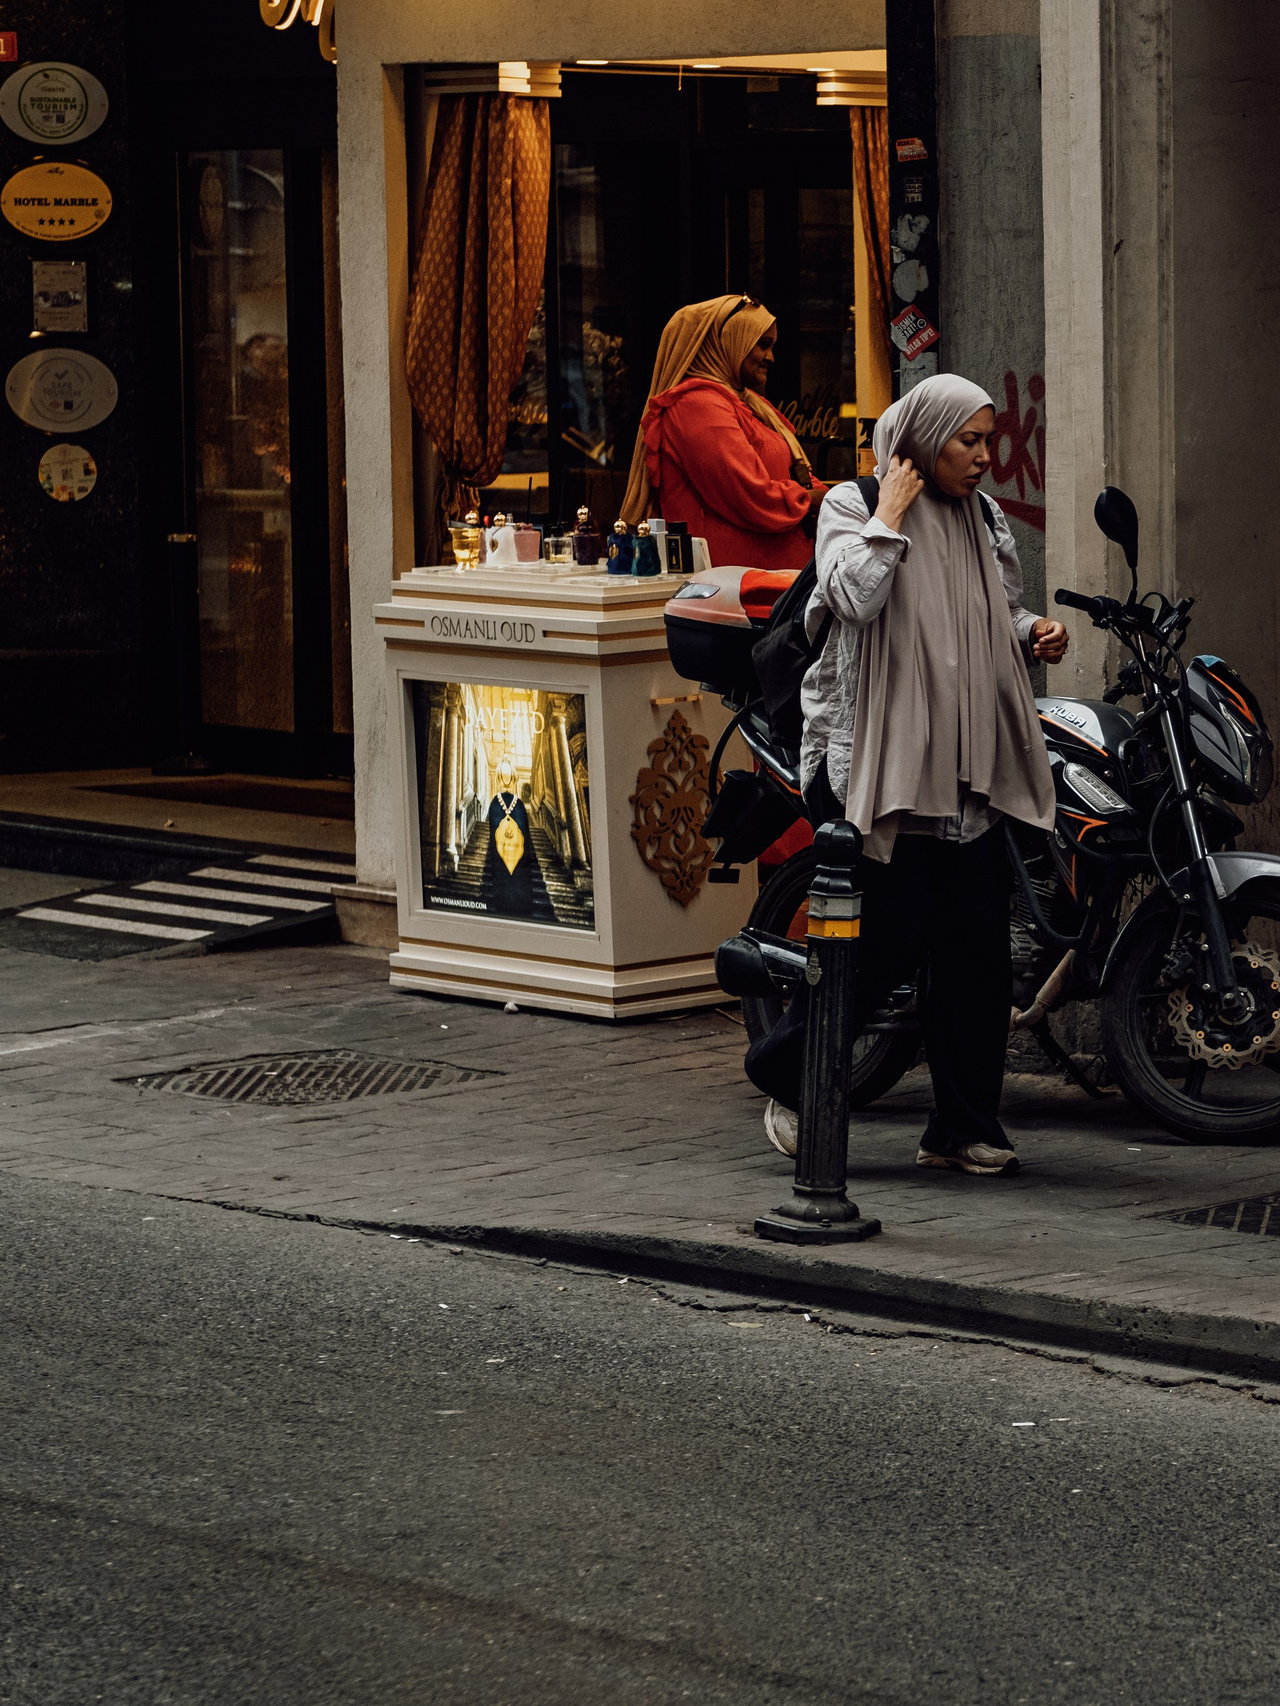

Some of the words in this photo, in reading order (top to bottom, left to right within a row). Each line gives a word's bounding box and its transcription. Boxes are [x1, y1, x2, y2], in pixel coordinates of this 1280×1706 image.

[14, 197, 50, 207] HOTEL
[53, 197, 99, 207] MARBLE
[431, 616, 497, 640] OSMANLI
[501, 621, 536, 643] OUD
[1050, 704, 1087, 728] KUBA
